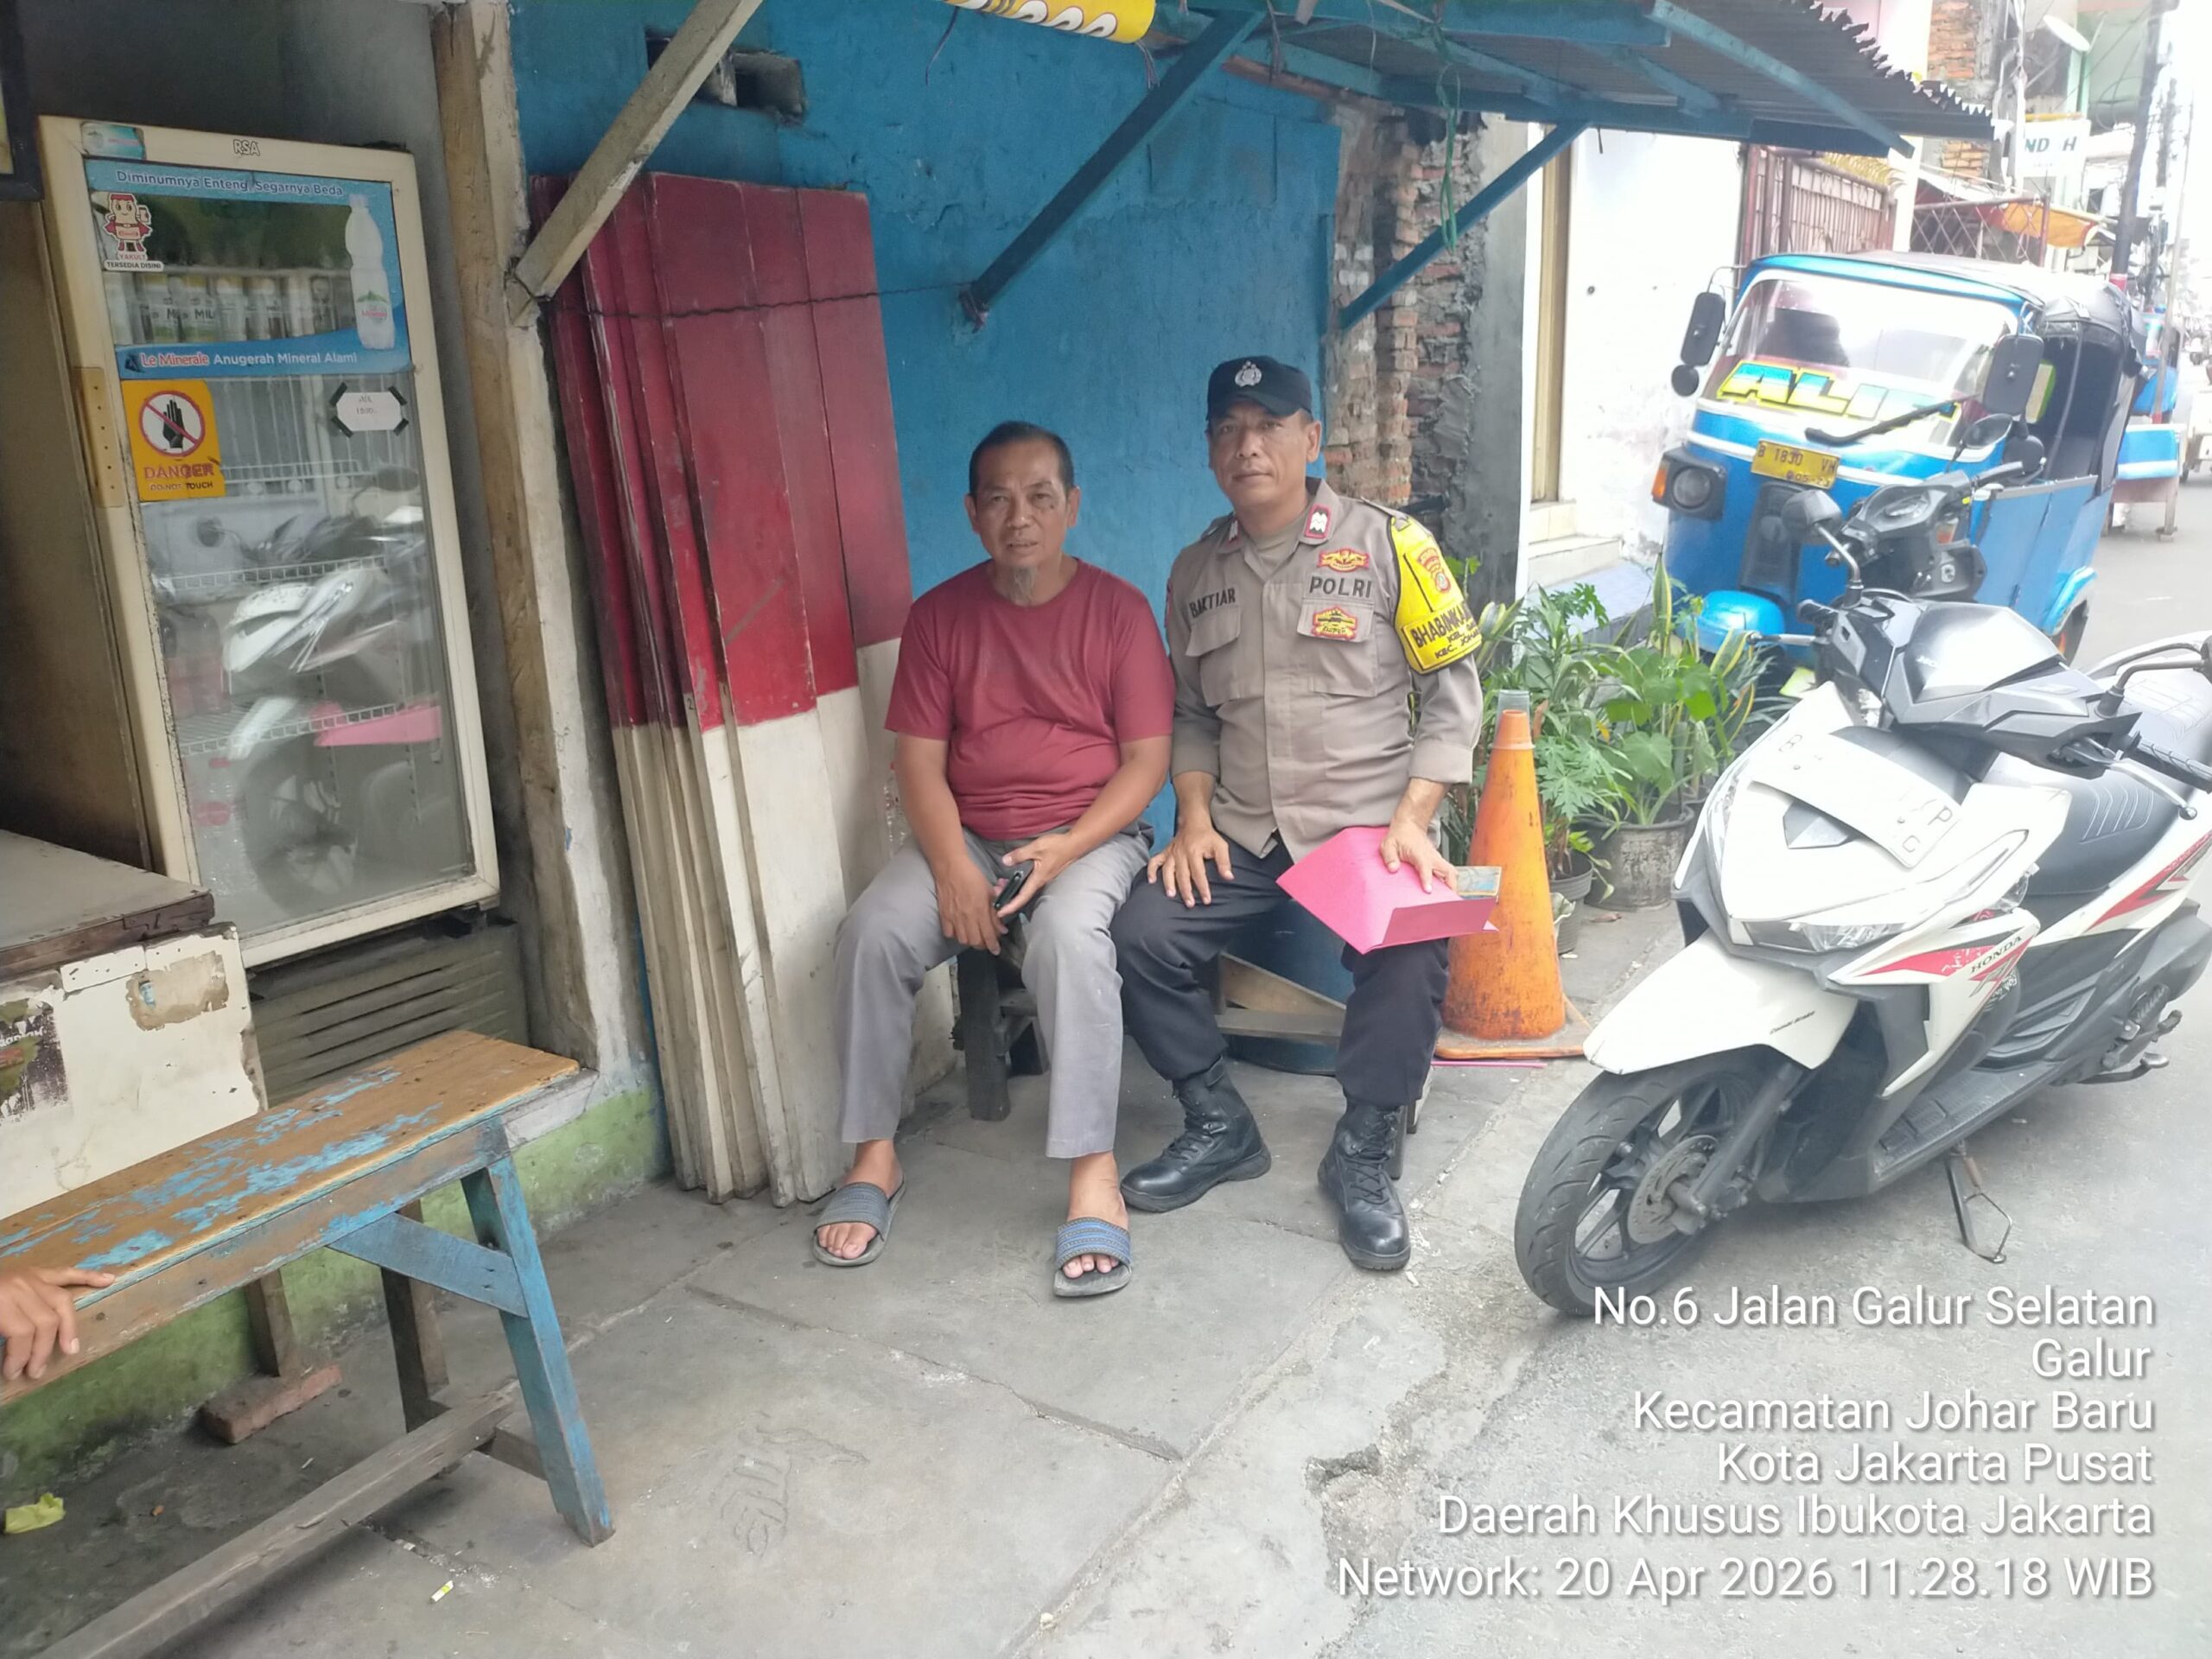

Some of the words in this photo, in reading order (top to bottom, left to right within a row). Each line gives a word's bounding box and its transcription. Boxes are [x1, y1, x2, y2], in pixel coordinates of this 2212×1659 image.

[232, 138, 260, 156] RSA
[117, 170, 200, 188] Diminumnya
[256, 180, 310, 195] Segarnya
[314, 183, 343, 196] Beda
[140, 352, 156, 368] Le
[159, 350, 210, 368] Minerale
[213, 353, 275, 367] Anugerah
[277, 352, 321, 365] Mineral
[324, 351, 358, 364] Alami
[144, 461, 214, 480] DANGER
[185, 480, 213, 491] TOUCH
[1308, 575, 1373, 599] POLRI
[1971, 935, 2023, 974] HONDA
